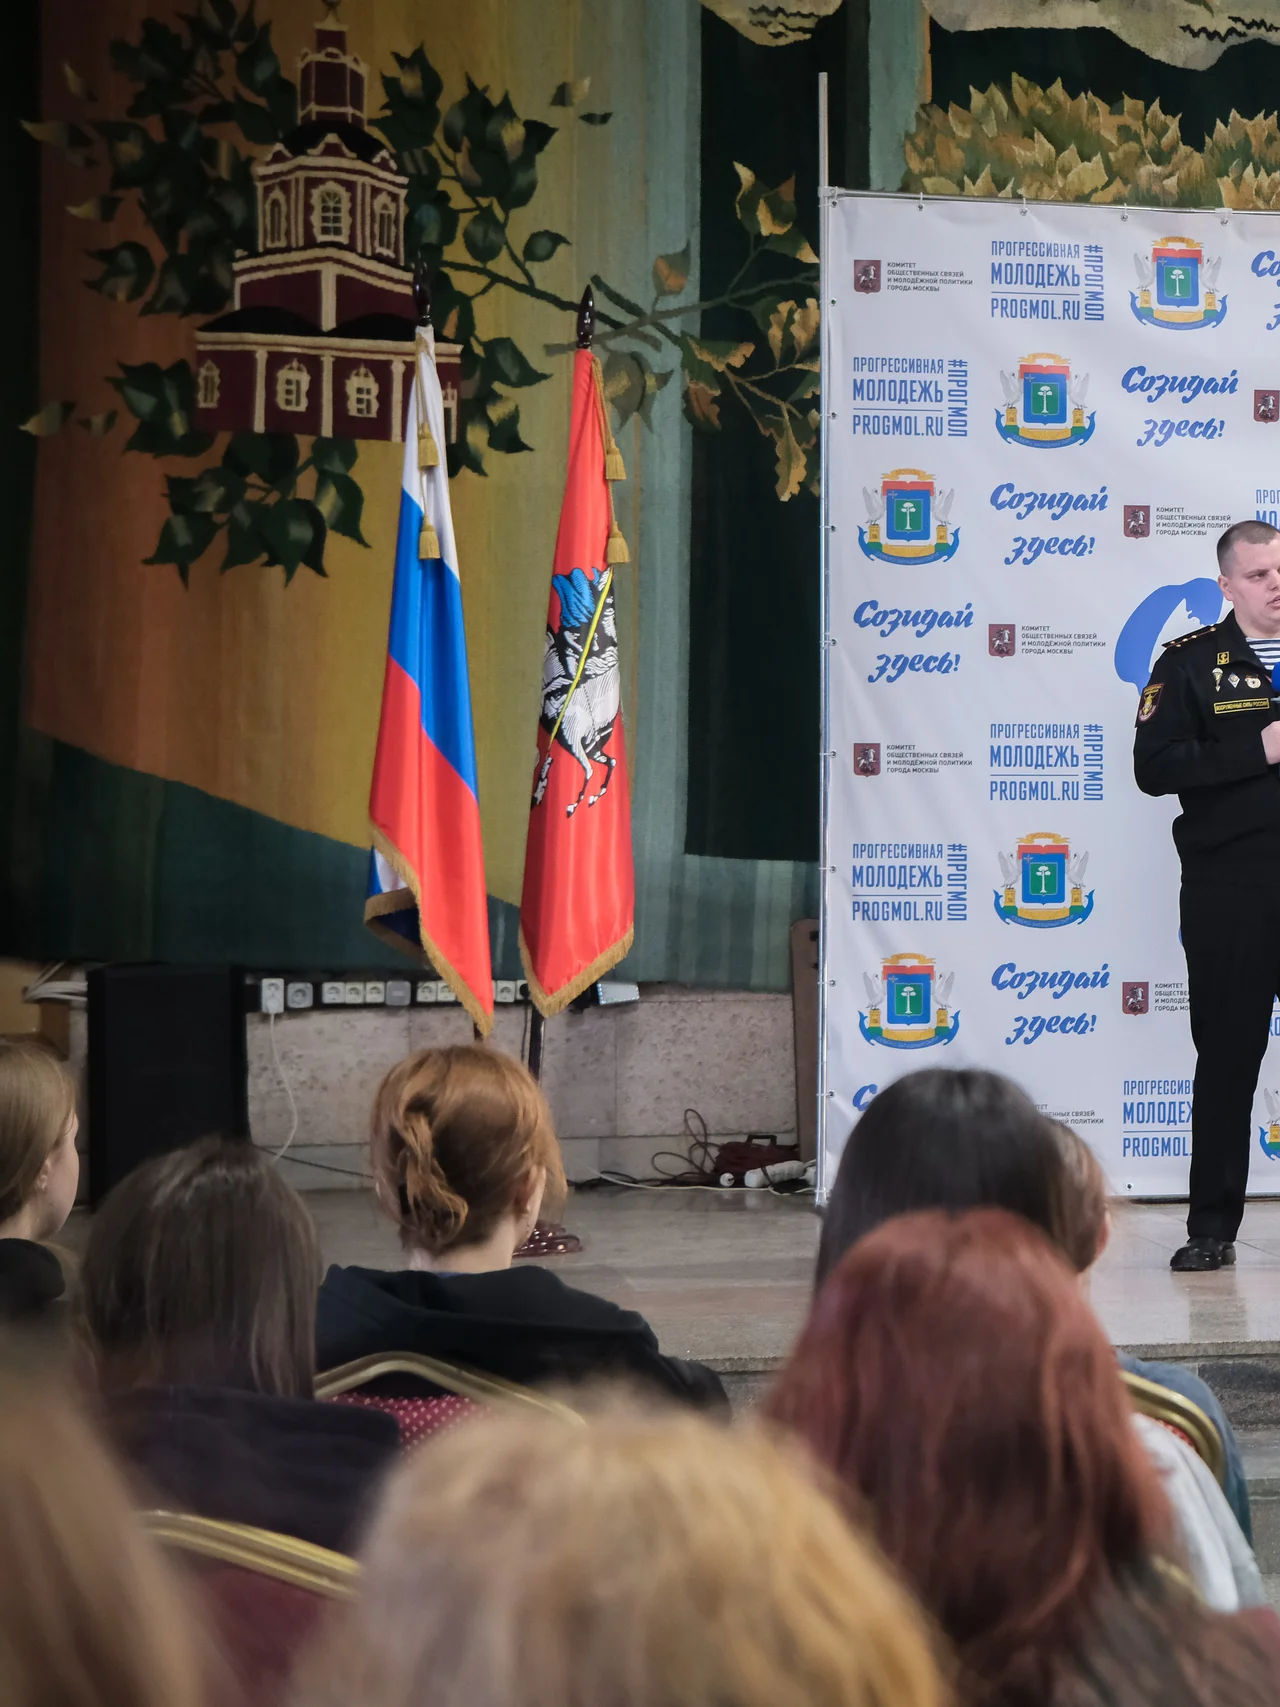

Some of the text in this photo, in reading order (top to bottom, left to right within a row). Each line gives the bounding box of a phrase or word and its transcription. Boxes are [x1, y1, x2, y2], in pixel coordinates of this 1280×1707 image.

[992, 240, 1080, 257] ПРОГРЕССИВНАЯ
[886, 269, 939, 277] ОБЩЕСТВЕННЫХ
[893, 277, 938, 285] МОЛОДЁЖНОЙ
[992, 263, 1080, 288] МОЛОДЕЖЬ
[1084, 246, 1104, 320] #ПРОГМОЛ
[992, 298, 1081, 320] PROGMOL.RU
[854, 357, 944, 374] ПРОГРЕССИВНАЯ
[854, 379, 944, 404] МОЛОДЕЖЬ
[1122, 366, 1238, 404] Созидай
[948, 360, 968, 436] #ПРОГМОЛ
[854, 415, 944, 436] PROGMOL.RU
[1137, 418, 1224, 447] здесь!
[990, 482, 1108, 520] Созидай
[1005, 536, 1096, 565] здесь!
[854, 600, 974, 638] Созидай
[868, 652, 960, 682] здесь!
[991, 724, 1080, 739] ПРОГРЕССИВНАЯ
[990, 745, 1080, 768] МОЛОДЕЖЬ
[1084, 724, 1104, 800] #ПРОГМОЛ
[990, 781, 1080, 800] PROGMOL.RU
[853, 843, 943, 858] ПРОГРЕССИВНАЯ
[853, 865, 943, 888] МОЛОДЕЖЬ
[948, 844, 968, 920] #ПРОГМОЛ
[853, 901, 943, 920] PROGMOL.RU
[992, 962, 1110, 1000] Созидай
[1006, 1013, 1096, 1045] здесь!
[1123, 1080, 1194, 1096] ПРОГРЕССИВ
[1123, 1136, 1192, 1157] PROGMOL.
